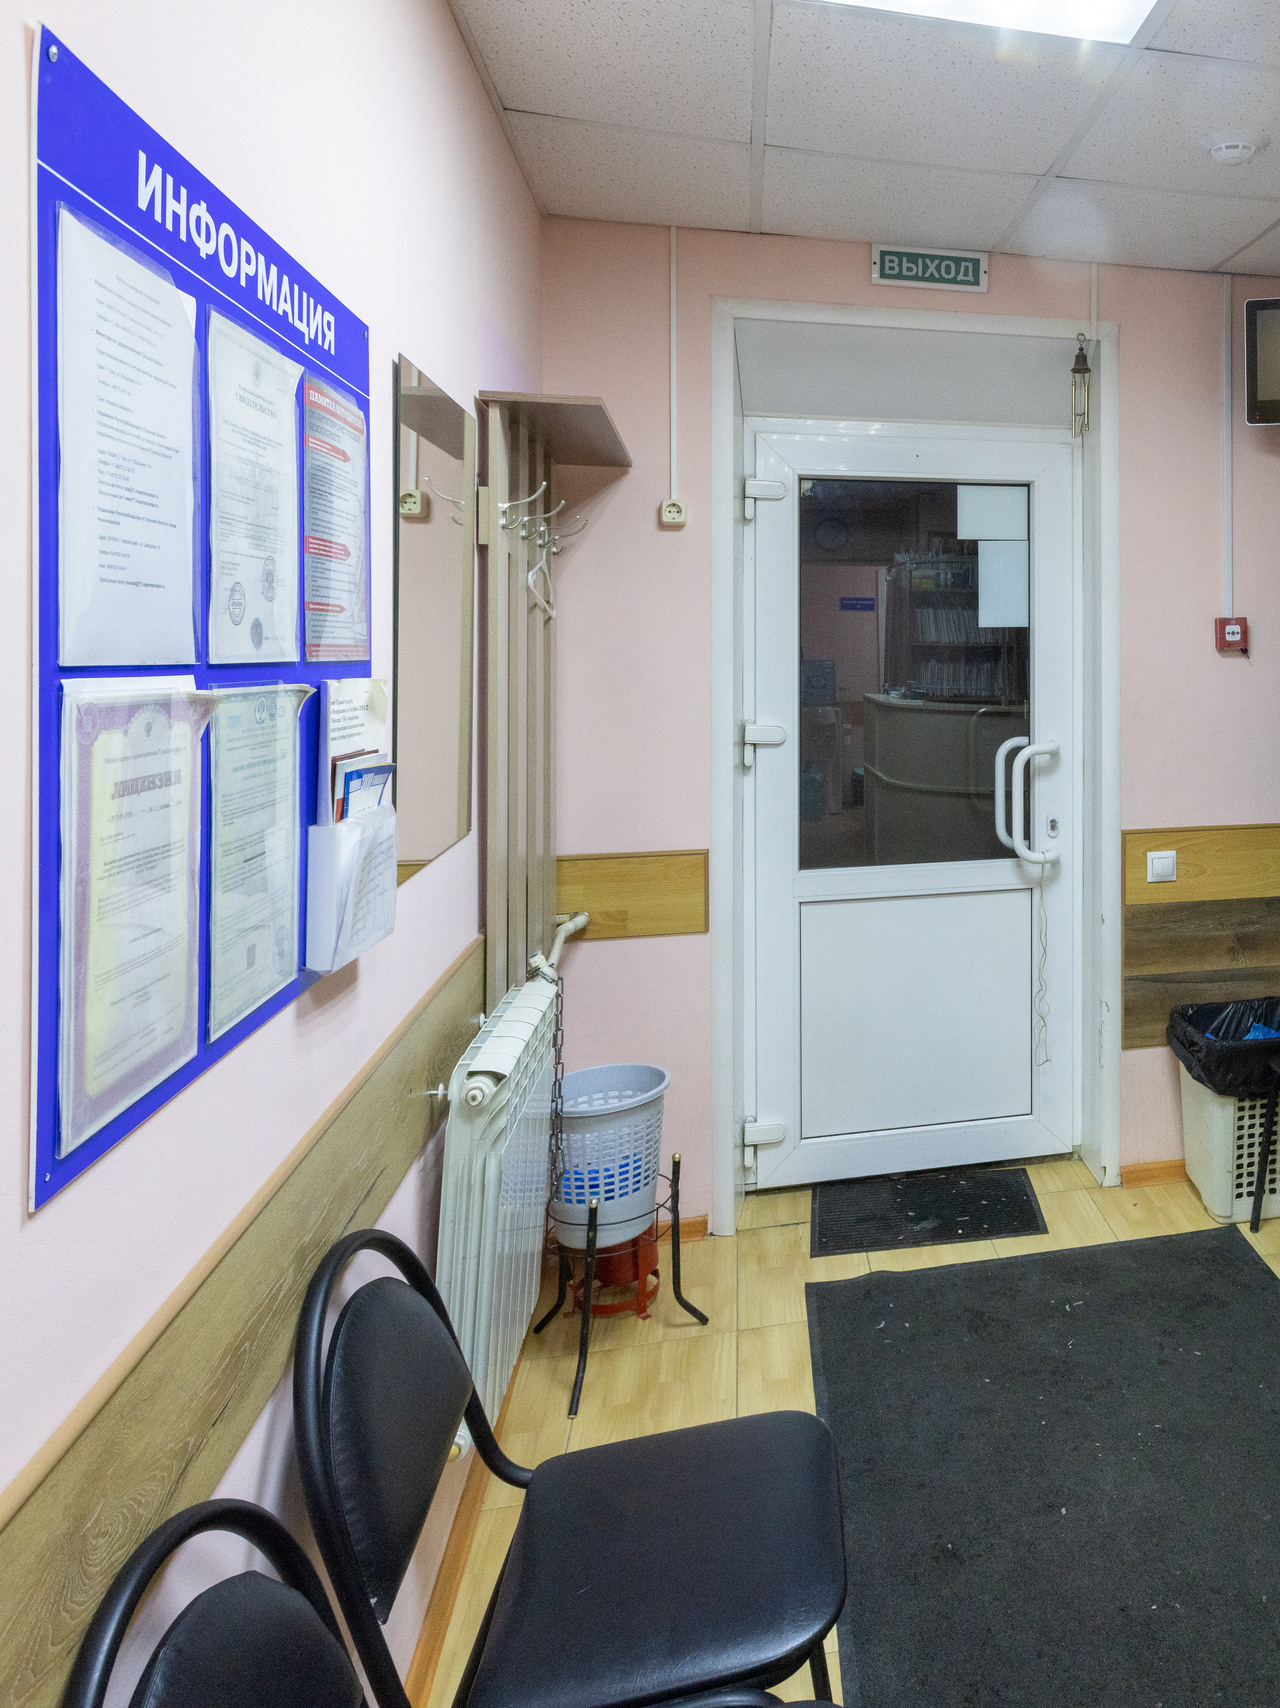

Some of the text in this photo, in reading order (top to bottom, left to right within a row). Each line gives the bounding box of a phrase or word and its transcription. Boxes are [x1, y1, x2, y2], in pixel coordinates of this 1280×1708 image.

[137, 150, 335, 356] ИНФОРМАЦИЯ
[884, 255, 974, 282] ВЫХОД
[111, 768, 182, 800] ЛИЦЕНЗИЯ
